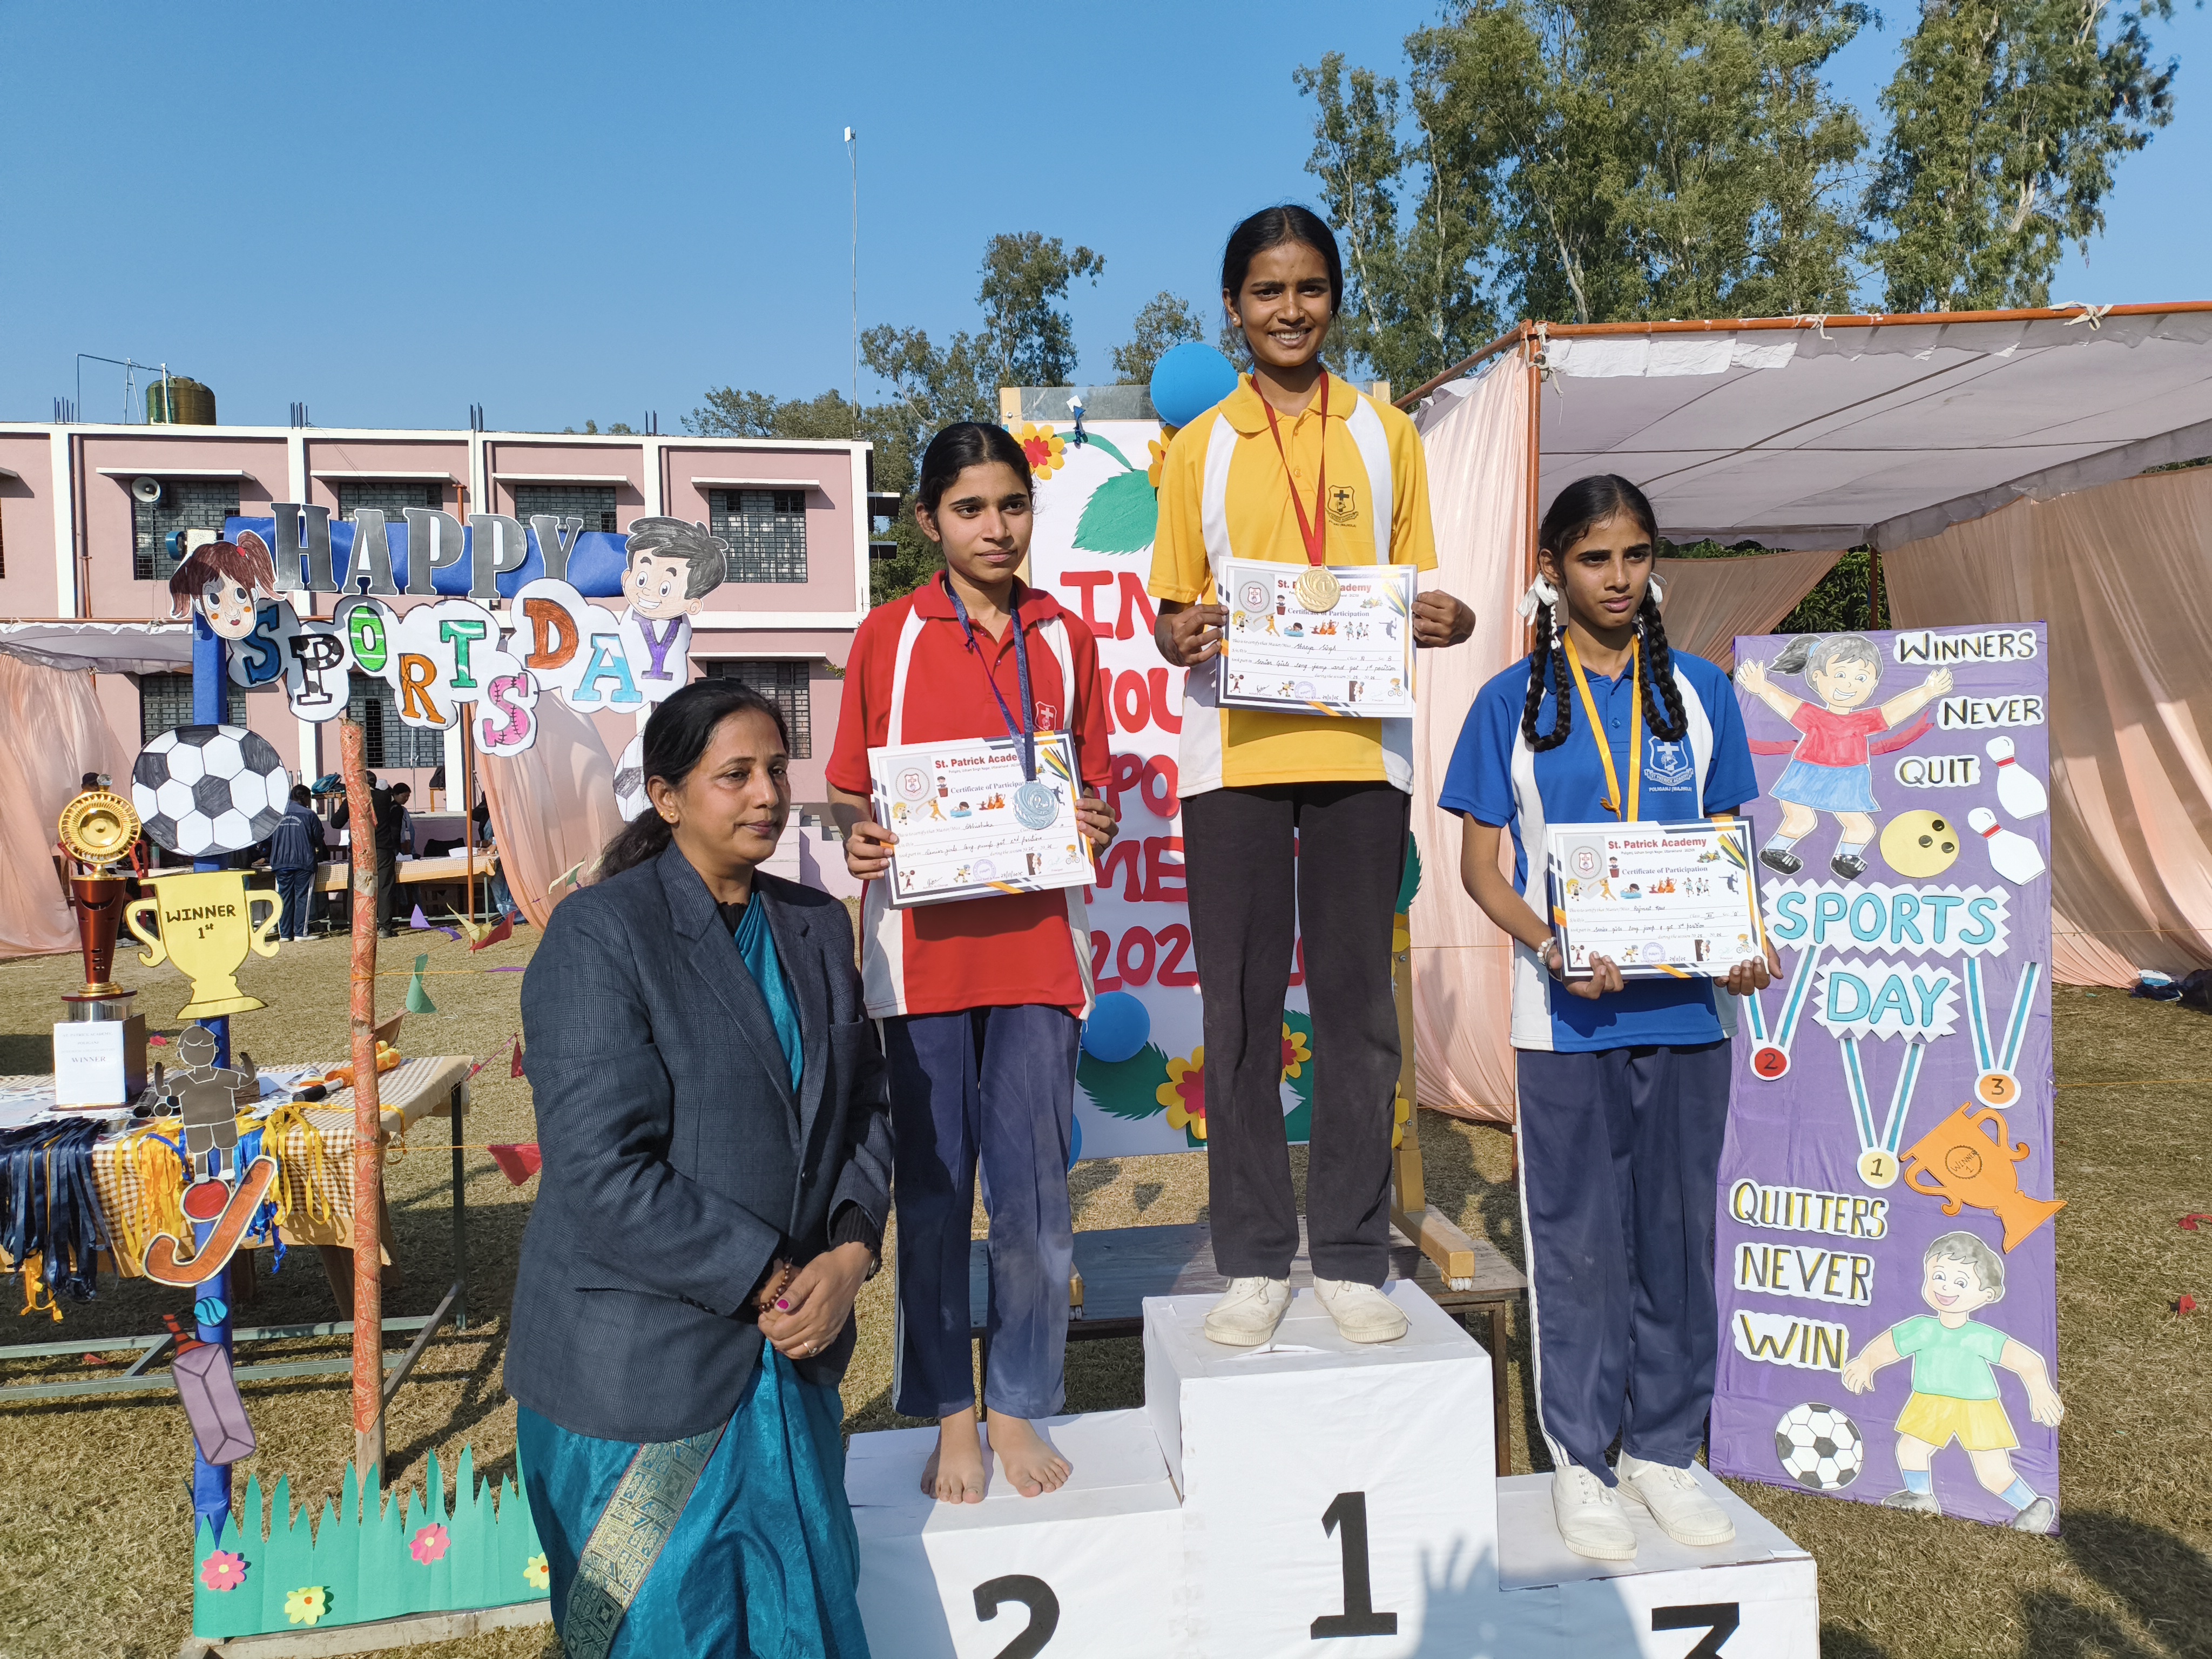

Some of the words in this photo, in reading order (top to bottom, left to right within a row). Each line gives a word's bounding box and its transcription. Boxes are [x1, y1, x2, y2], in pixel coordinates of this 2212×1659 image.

[271, 503, 583, 598] HAPPY
[1278, 580, 1290, 588] St.
[1340, 583, 1371, 594] ademy
[1060, 570, 1157, 640] IN
[1899, 632, 2034, 662] WINNERS
[244, 605, 528, 747] SPORTS
[523, 598, 682, 703] DAY
[1943, 698, 2041, 726] NEVER
[935, 760, 948, 768] St.
[951, 756, 985, 767] Patrick
[988, 753, 1019, 764] Acade
[1899, 757, 1976, 785] QUIT
[950, 785, 984, 794] Certificate
[994, 780, 1034, 790] Participaton
[1608, 841, 1621, 849] St.
[1624, 839, 1658, 849] Patrick
[1662, 838, 1707, 847] Academy
[1084, 836, 1188, 904] ME
[165, 904, 237, 923] WINNER
[1773, 891, 1998, 945] SPORTS
[198, 923, 214, 939] 1st
[1090, 923, 1199, 995] 202
[1826, 972, 1950, 1027] DAY
[1764, 1053, 1778, 1070] 2
[1991, 1077, 2005, 1096] 3
[1870, 1158, 1883, 1177] 1
[1951, 1150, 1977, 1172] WINNER
[1734, 1181, 1886, 1238] QUITTERS
[1741, 1246, 1869, 1300] NEVER
[1739, 1314, 1843, 1368] WIN
[1311, 1491, 1397, 1640] 1
[973, 1574, 1060, 1659] 2
